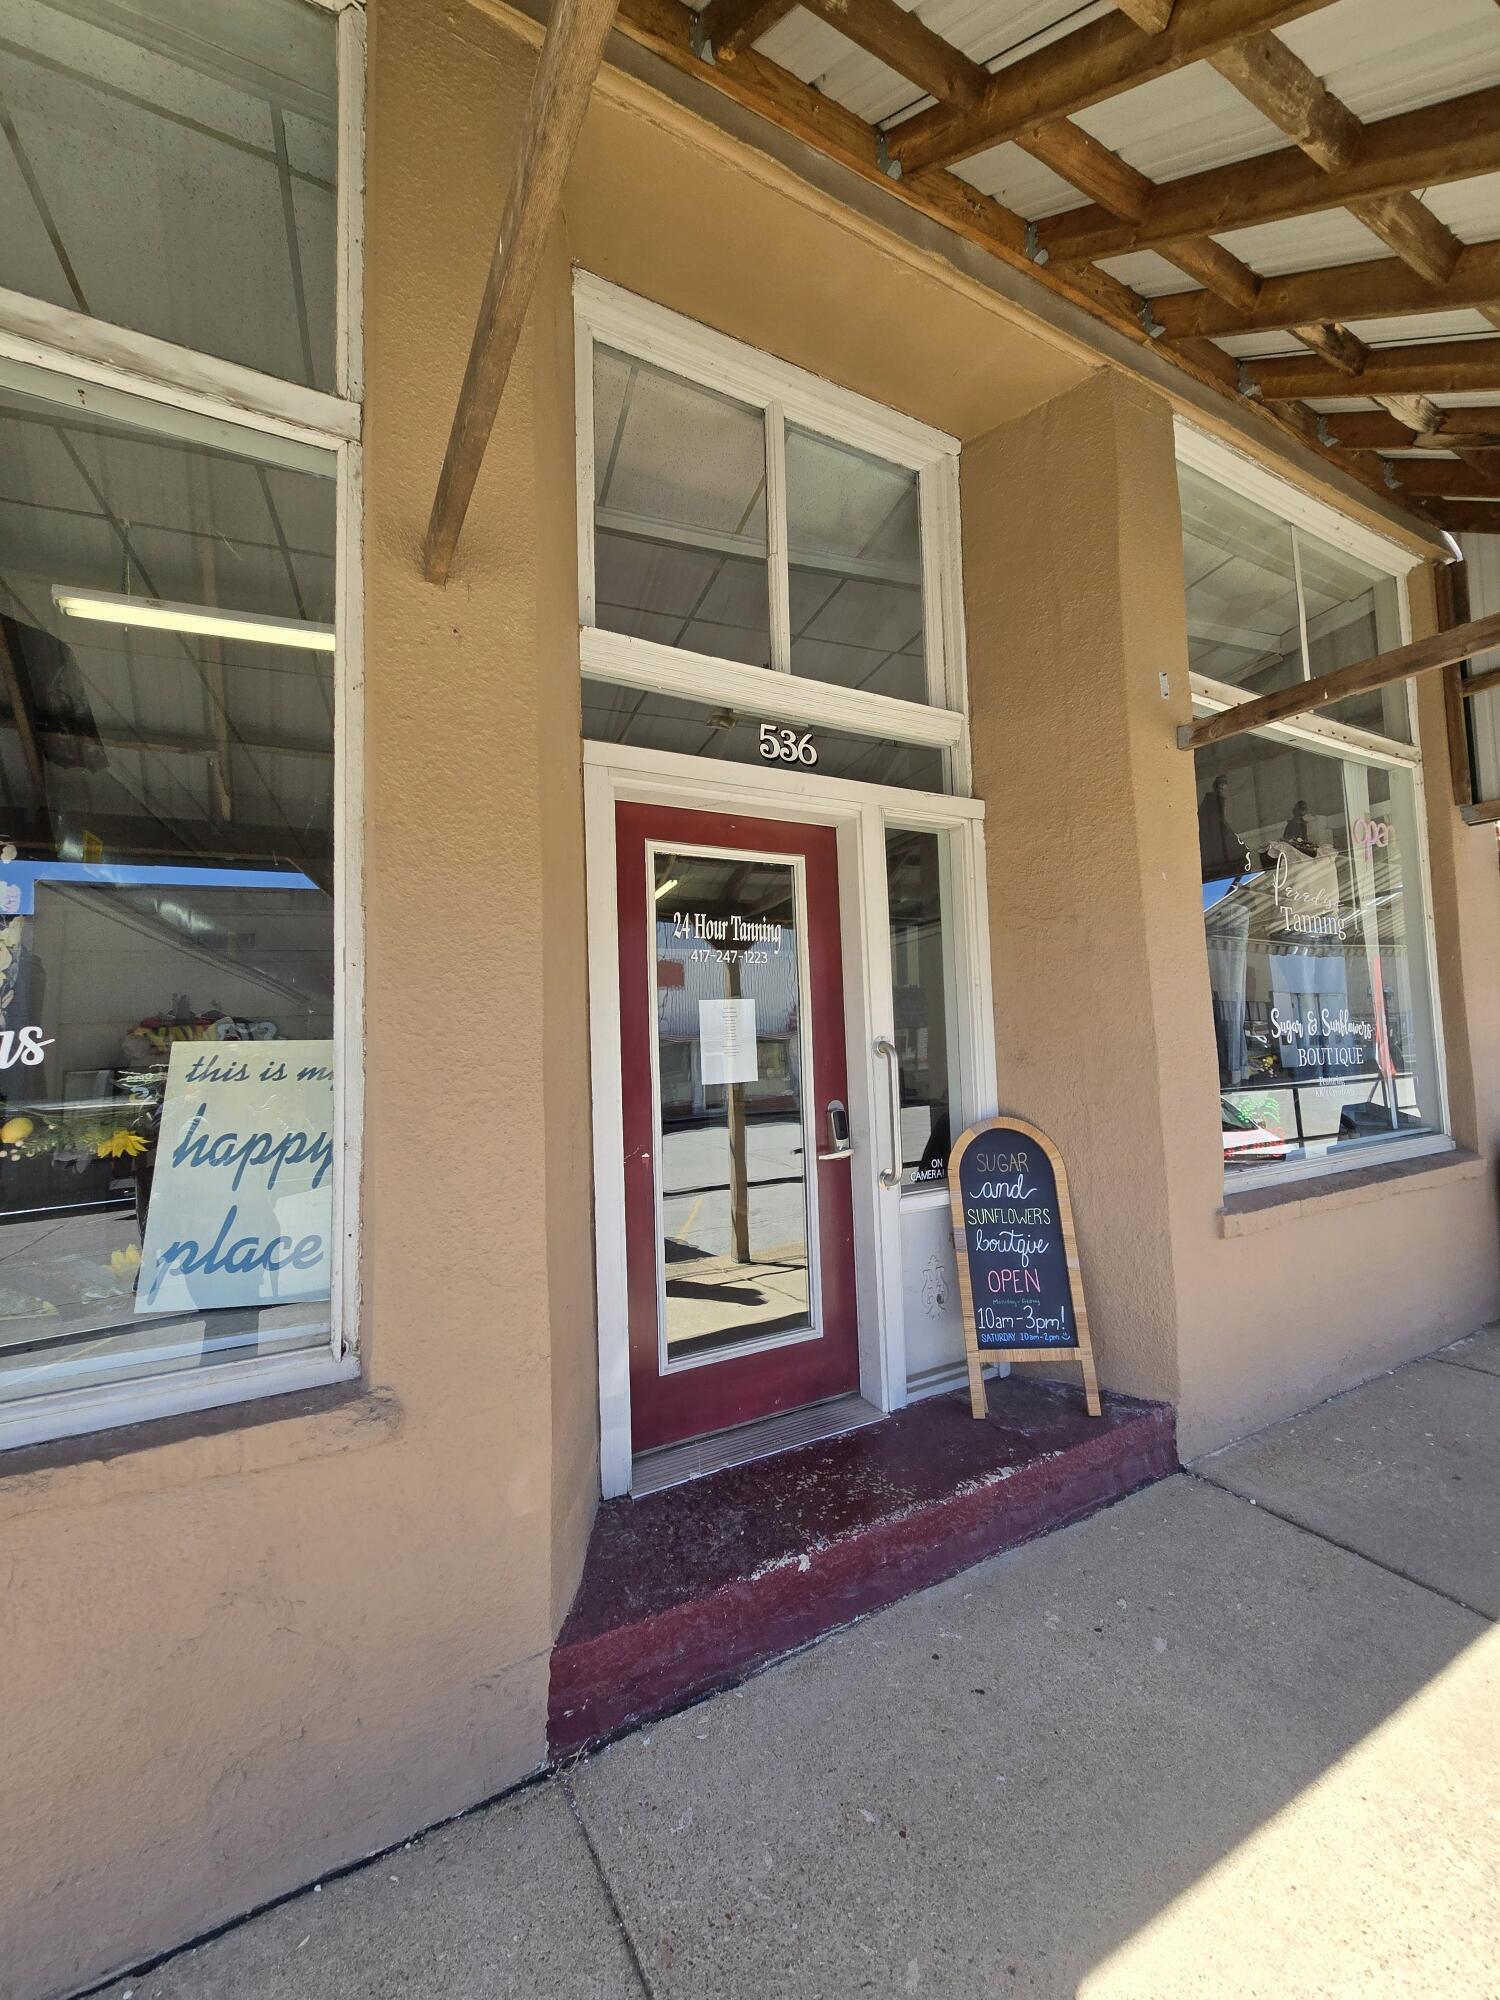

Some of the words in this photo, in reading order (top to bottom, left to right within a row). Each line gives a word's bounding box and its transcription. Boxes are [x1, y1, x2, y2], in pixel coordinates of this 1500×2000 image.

[759, 723, 818, 766] 536
[673, 911, 690, 939] 24
[693, 913, 729, 941] Hour
[730, 915, 782, 954] Tanning
[1280, 906, 1346, 940] Tanning
[690, 949, 768, 964] 417-247-1223
[1271, 1008, 1303, 1043] Sugar
[1307, 1011, 1318, 1036] &
[1321, 1008, 1373, 1039] Sunflowers
[185, 1055, 250, 1083] this
[259, 1061, 288, 1081] is
[1298, 1047, 1364, 1067] BOUTIQUE
[172, 1102, 333, 1192] happy
[931, 1159, 943, 1168] ON
[976, 1152, 1029, 1172] SUGAR
[910, 1168, 945, 1182] CAMERA!
[969, 1173, 1038, 1199] and
[967, 1207, 1051, 1225] SUNFLOWERS
[147, 1204, 324, 1306] place
[988, 1268, 1041, 1293] OPEN
[981, 1332, 1016, 1343] SATURDAY
